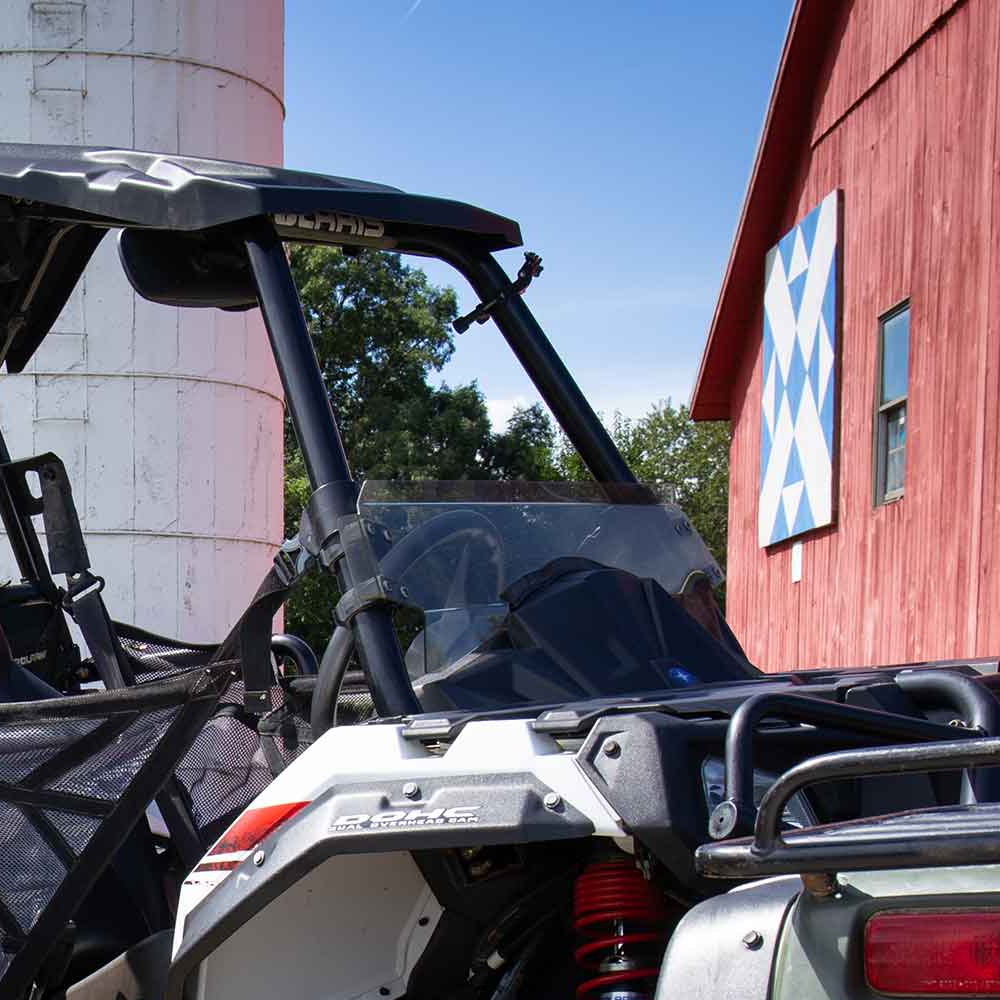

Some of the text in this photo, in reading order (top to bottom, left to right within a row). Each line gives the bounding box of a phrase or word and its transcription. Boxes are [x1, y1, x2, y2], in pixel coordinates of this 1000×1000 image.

[332, 806, 481, 825] DOHC
[369, 818, 445, 829] OVERHEAD
[447, 816, 480, 824] CAM
